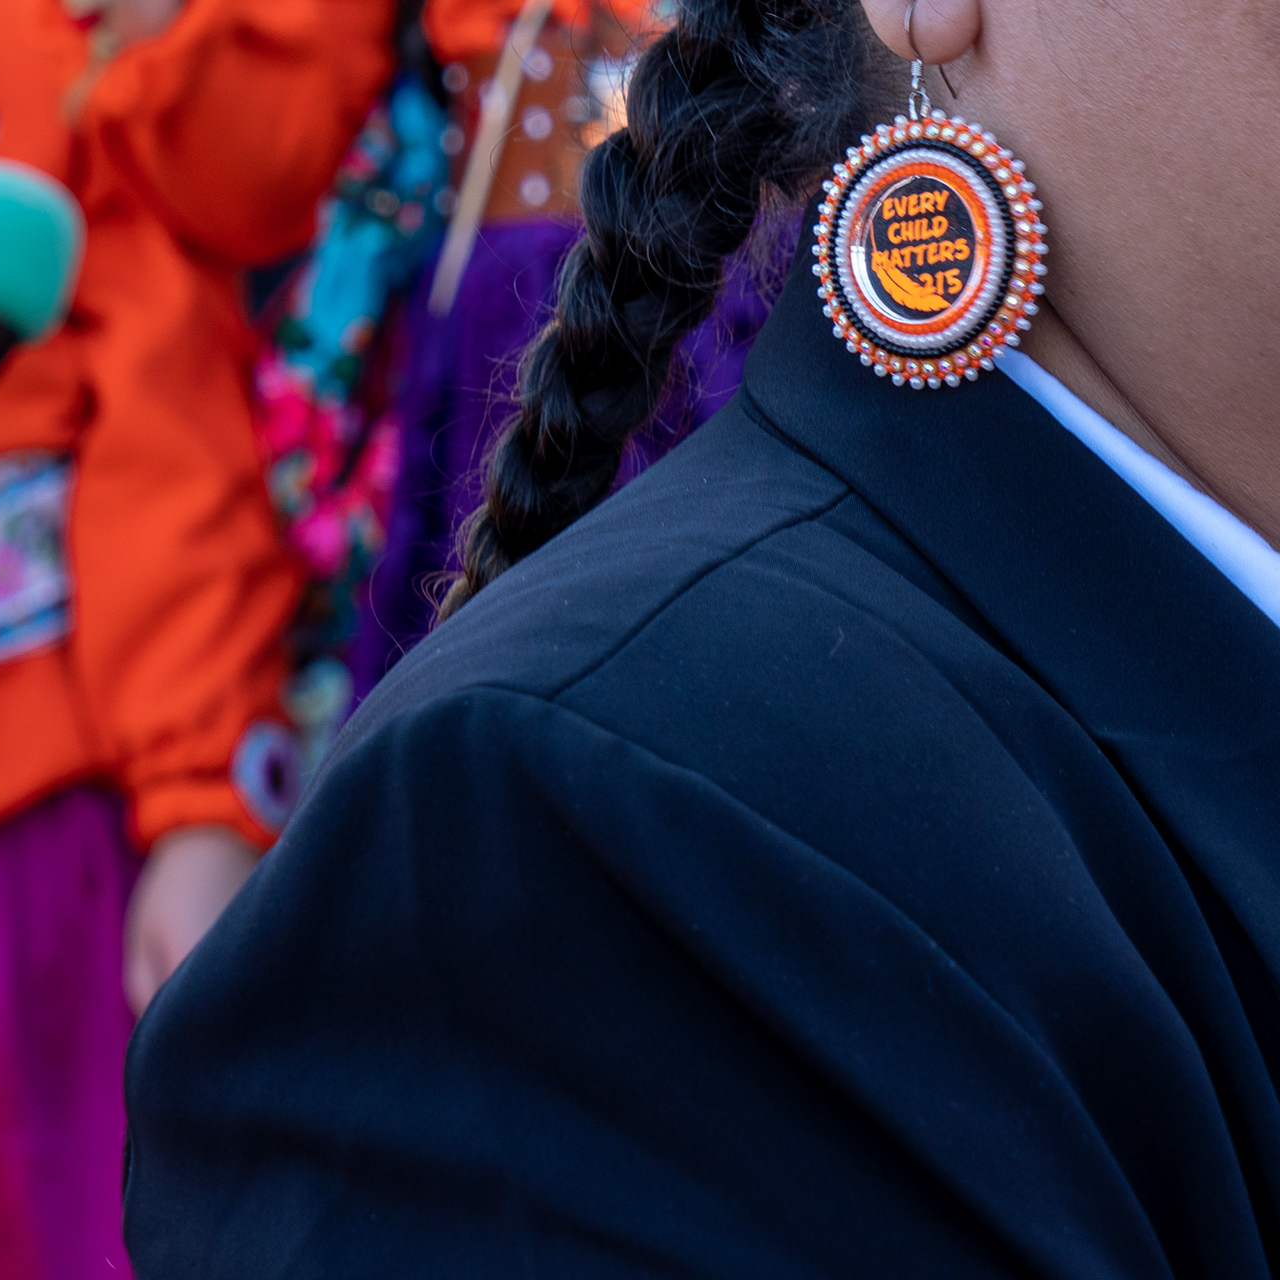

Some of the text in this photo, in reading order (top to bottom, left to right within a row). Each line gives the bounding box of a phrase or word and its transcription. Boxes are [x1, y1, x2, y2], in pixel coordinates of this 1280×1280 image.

[882, 190, 949, 220] EVERY
[887, 216, 949, 244] CHILD
[871, 238, 970, 272] MATTERS
[919, 268, 963, 295] 215
